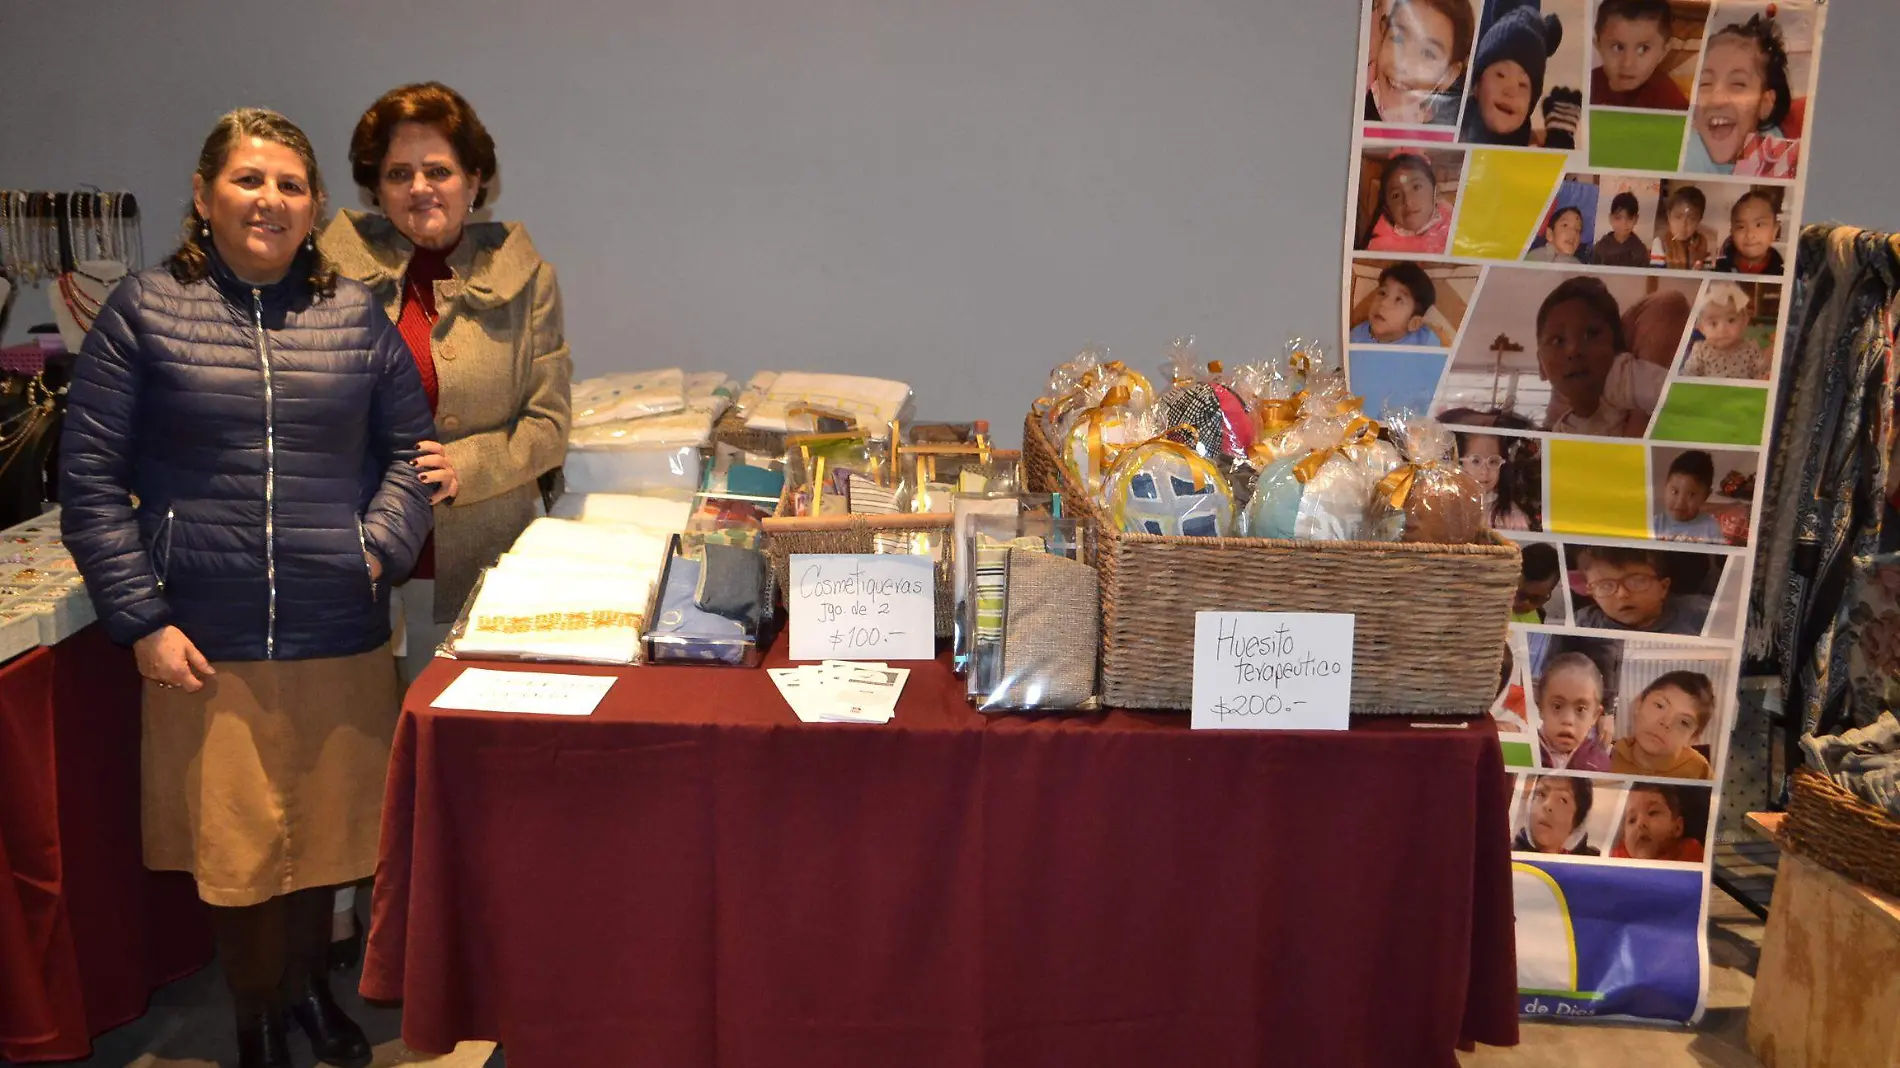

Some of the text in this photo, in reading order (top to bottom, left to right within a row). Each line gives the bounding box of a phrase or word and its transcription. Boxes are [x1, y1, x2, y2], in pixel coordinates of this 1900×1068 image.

[800, 562, 922, 603] Cosmetiqueras
[851, 601, 867, 615] de
[877, 603, 890, 615] 2
[1216, 617, 1294, 661] Huesito
[1524, 998, 1549, 1013] de
